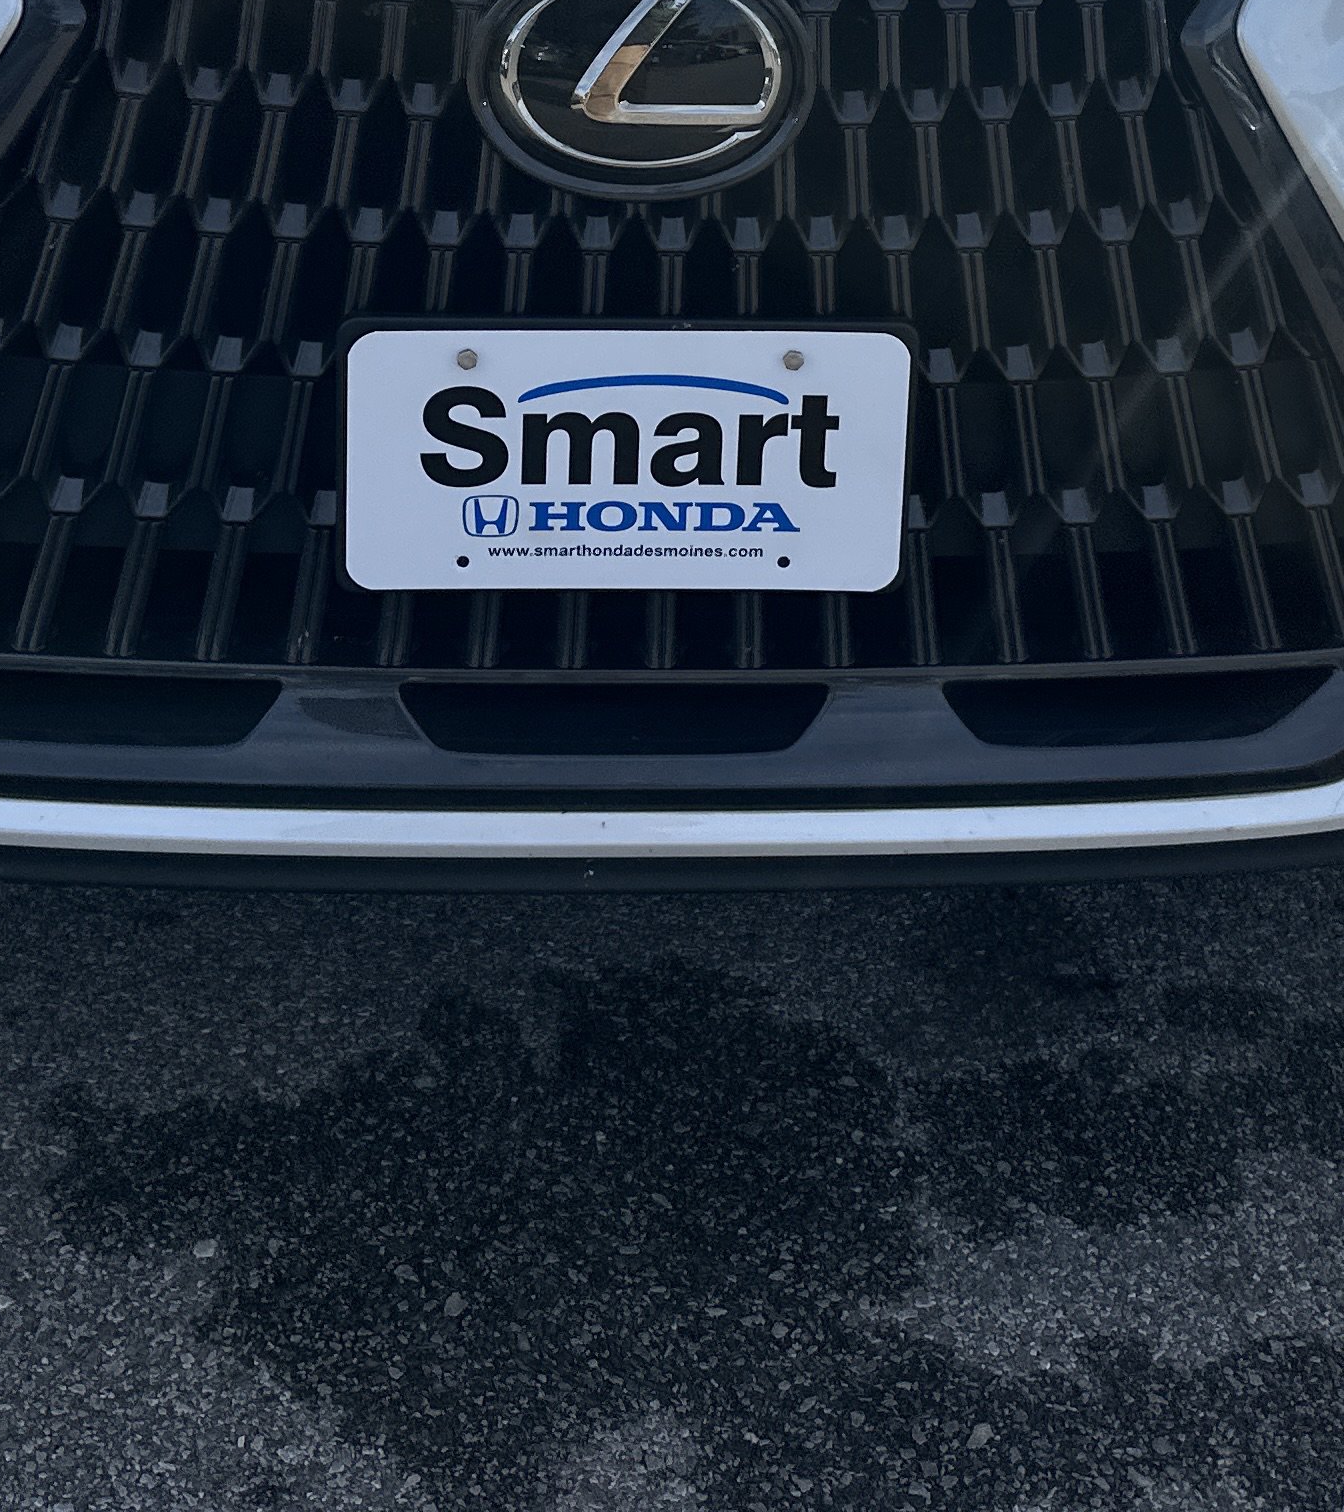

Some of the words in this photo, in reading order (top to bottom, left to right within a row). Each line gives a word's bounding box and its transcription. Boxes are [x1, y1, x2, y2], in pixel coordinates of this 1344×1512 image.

[419, 385, 840, 488] Smart
[529, 500, 801, 533] HONDA
[487, 544, 764, 558] www.smarthondadesmoines.com
